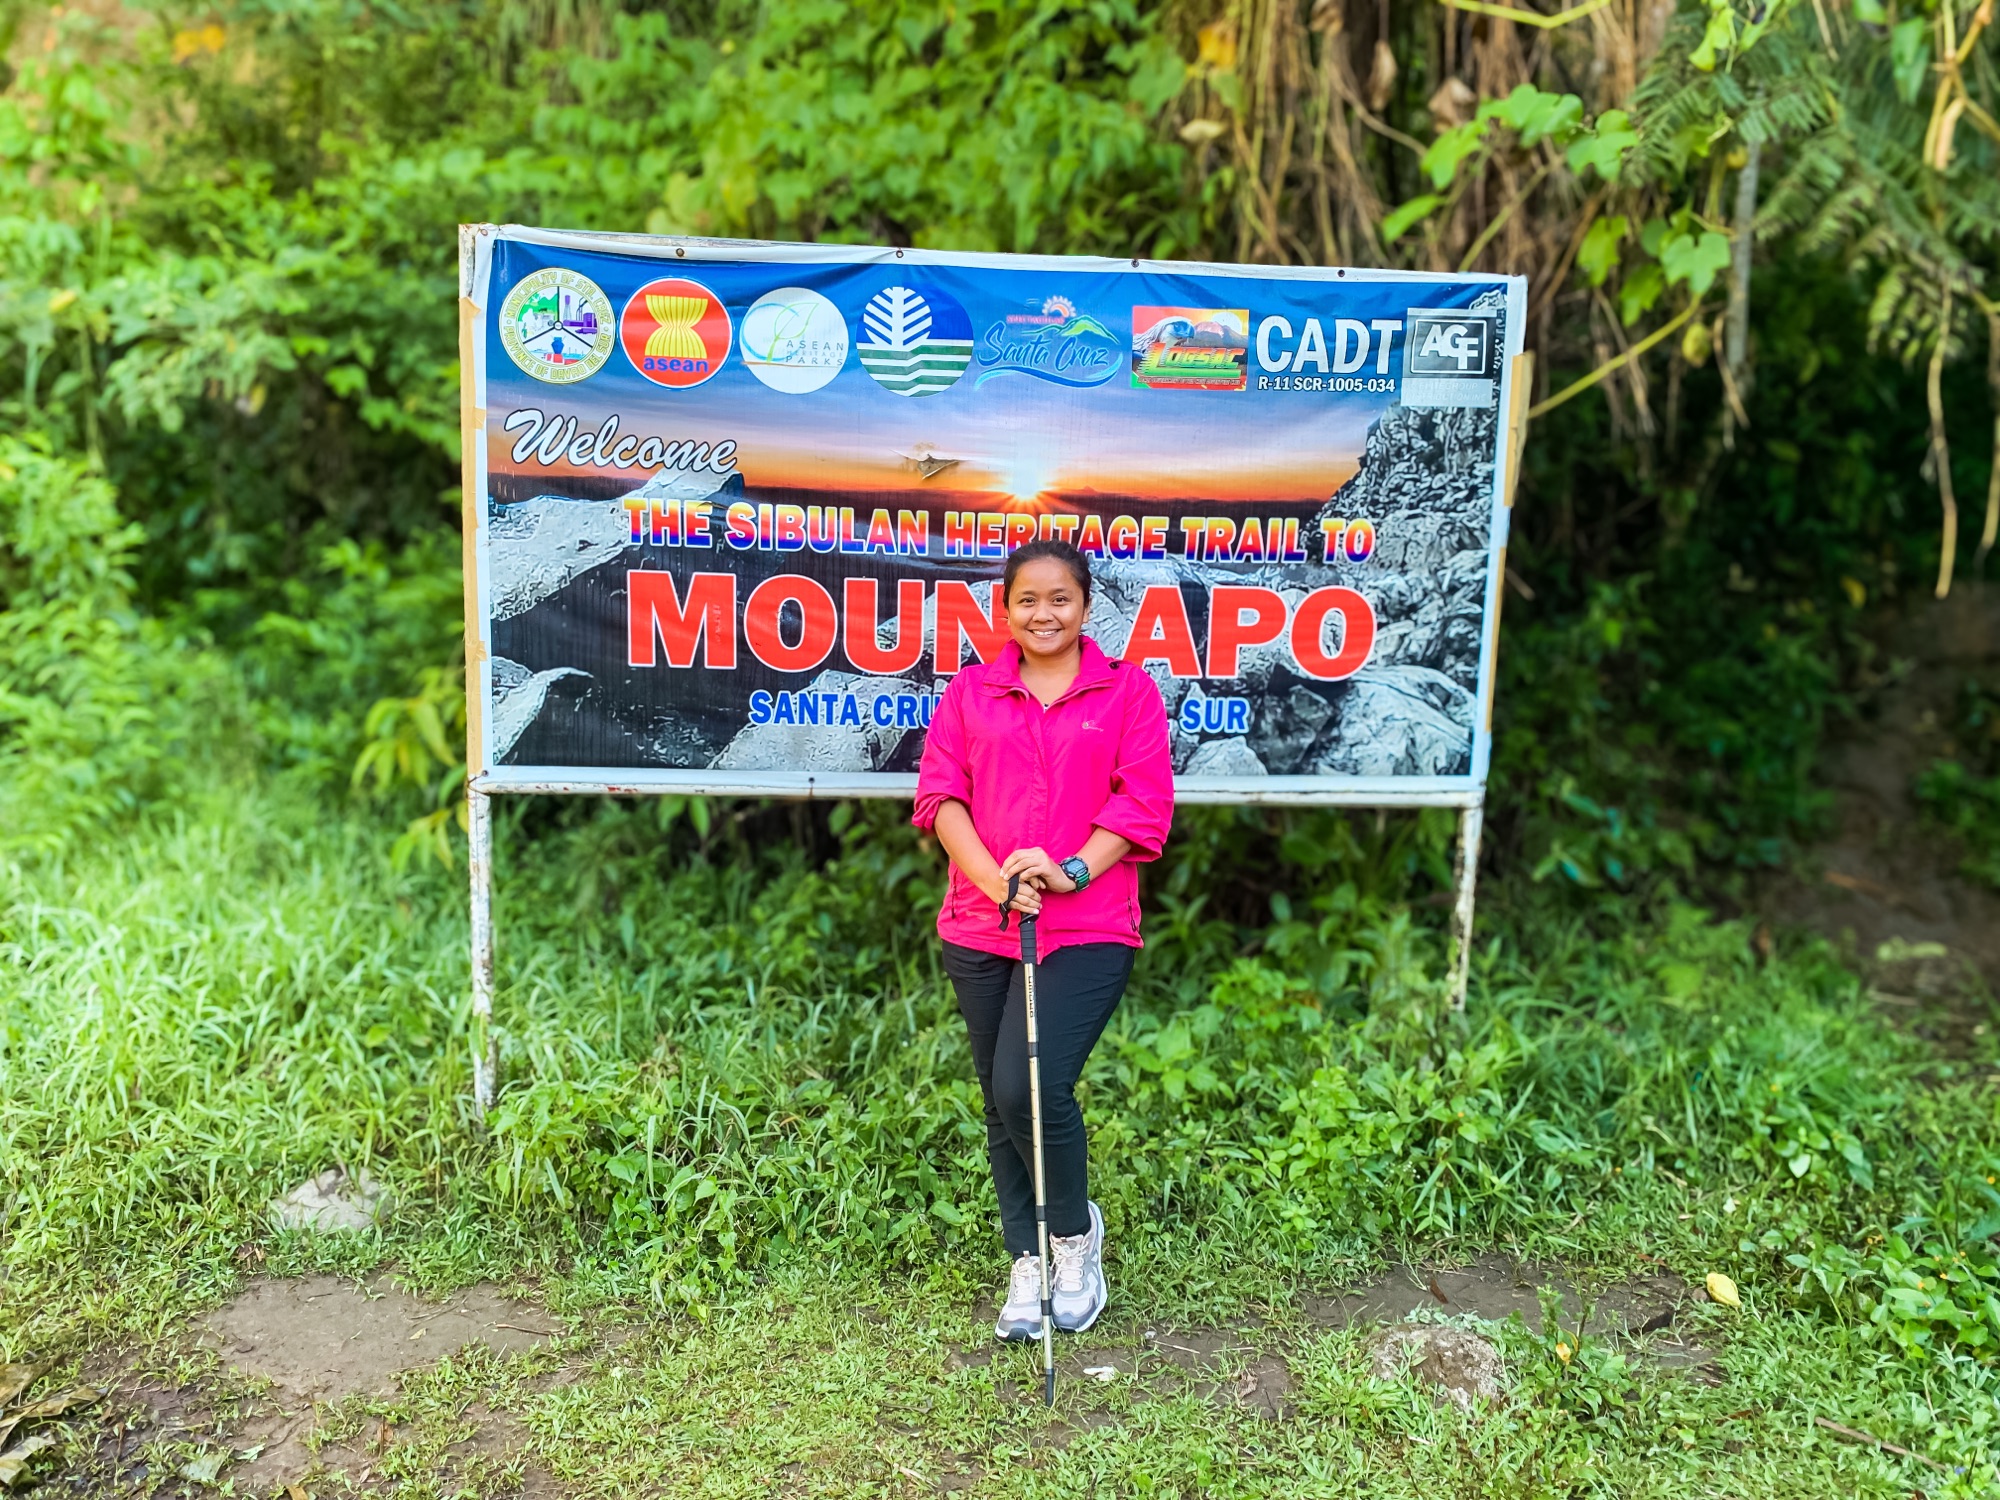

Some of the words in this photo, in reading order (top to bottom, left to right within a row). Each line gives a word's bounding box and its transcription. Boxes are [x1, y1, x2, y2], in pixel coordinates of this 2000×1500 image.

[506, 272, 558, 319] MUNICIPALITY
[561, 272, 575, 284] OF
[594, 297, 612, 325] CRUZ
[503, 326, 535, 368] PROVINCE
[534, 365, 550, 378] OF
[550, 365, 587, 380] DAVAO
[585, 353, 604, 370] DEL
[596, 333, 612, 355] SUR
[643, 356, 708, 373] asean
[785, 355, 844, 366] PARKS
[787, 340, 844, 351] ASEAN
[976, 320, 1051, 367] Santa
[1054, 335, 1110, 372] Cruz
[1256, 315, 1403, 375] CADT
[1419, 324, 1479, 369] AGF
[1258, 375, 1291, 391] R-11
[1293, 376, 1396, 392] SCR-1005-034
[504, 408, 738, 474] Welcome
[623, 498, 713, 548] THE
[724, 501, 930, 557] SIBULAN
[944, 511, 1170, 563] HERITAGE
[1180, 516, 1308, 564] TRAIL
[1321, 517, 1376, 566] TO
[627, 569, 1010, 675] MOUN
[1120, 585, 1378, 681] APO
[749, 690, 862, 727] SANTA
[873, 694, 943, 729] CRU
[1179, 696, 1250, 734] SUR
